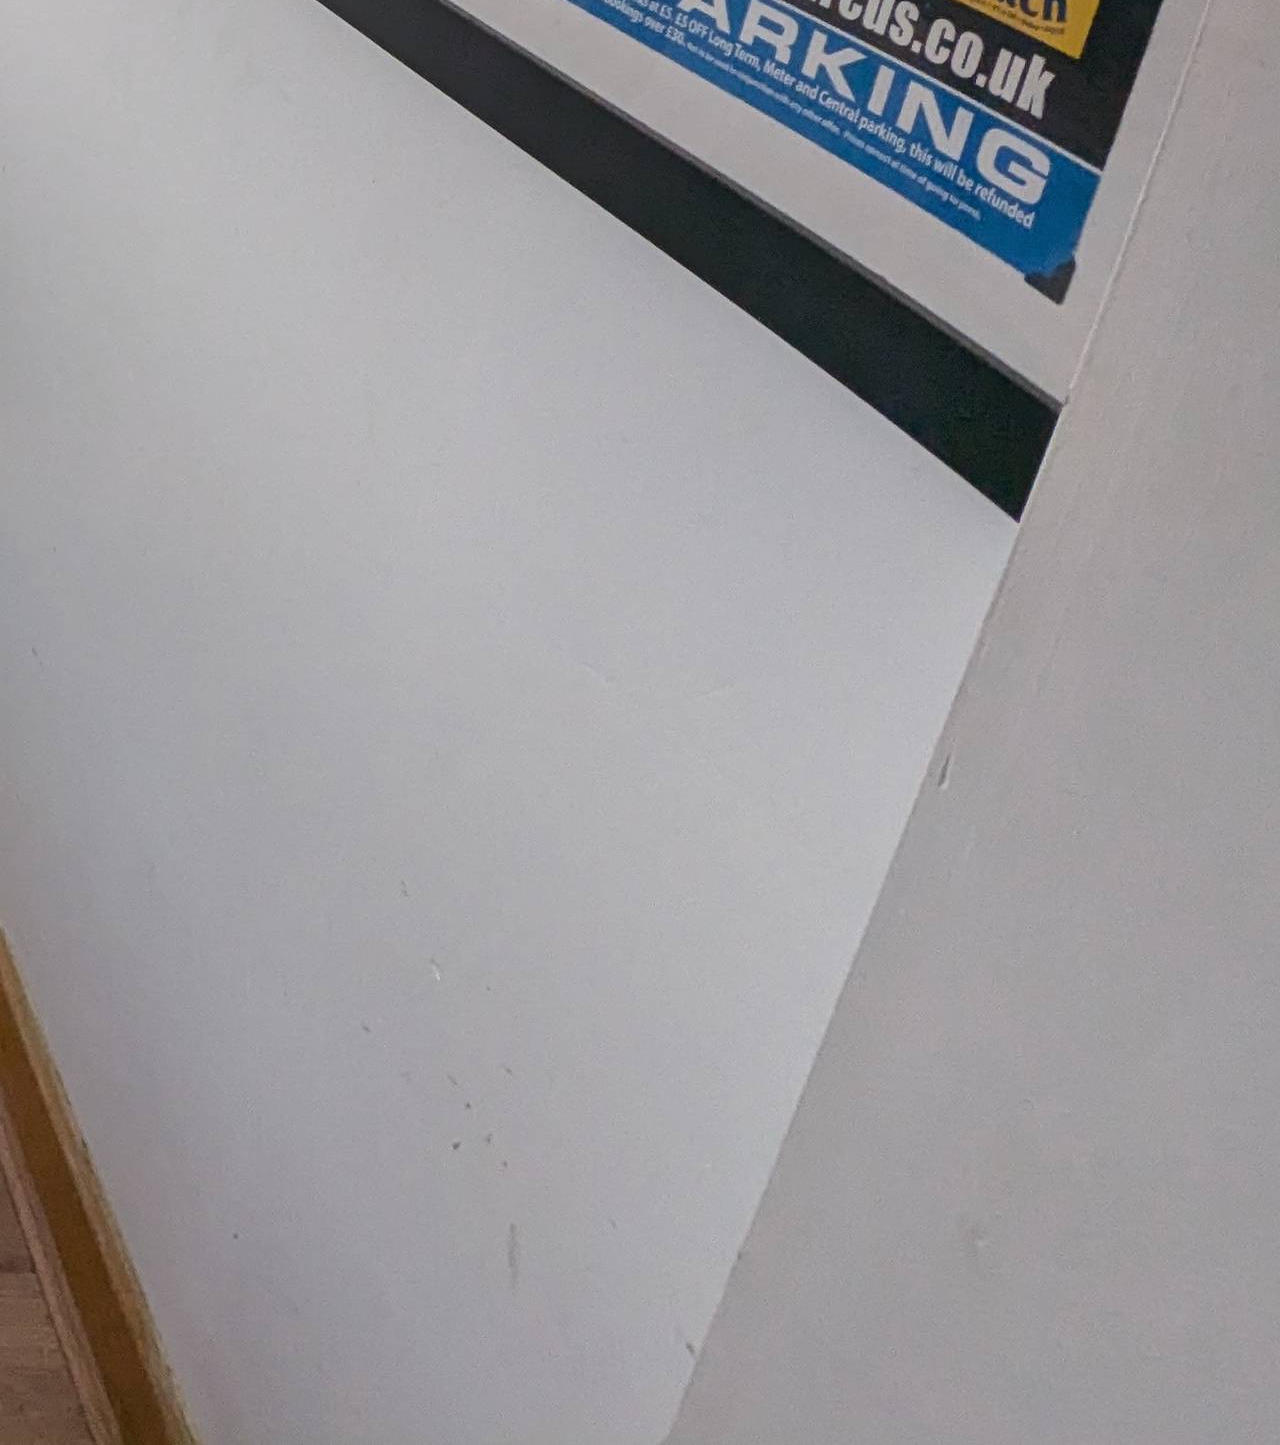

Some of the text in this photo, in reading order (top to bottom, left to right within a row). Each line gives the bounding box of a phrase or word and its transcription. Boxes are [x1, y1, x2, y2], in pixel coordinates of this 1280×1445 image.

[643, 16, 666, 36] over
[687, 18, 708, 39] OFF
[708, 30, 734, 57] Long
[732, 41, 762, 72] Term,
[762, 60, 795, 88] Meter
[794, 77, 818, 100] and
[818, 89, 861, 125] Central
[859, 114, 908, 154] parking,
[908, 141, 934, 167] this
[932, 155, 957, 182] will
[956, 168, 974, 191] be
[973, 181, 1036, 230] refunded
